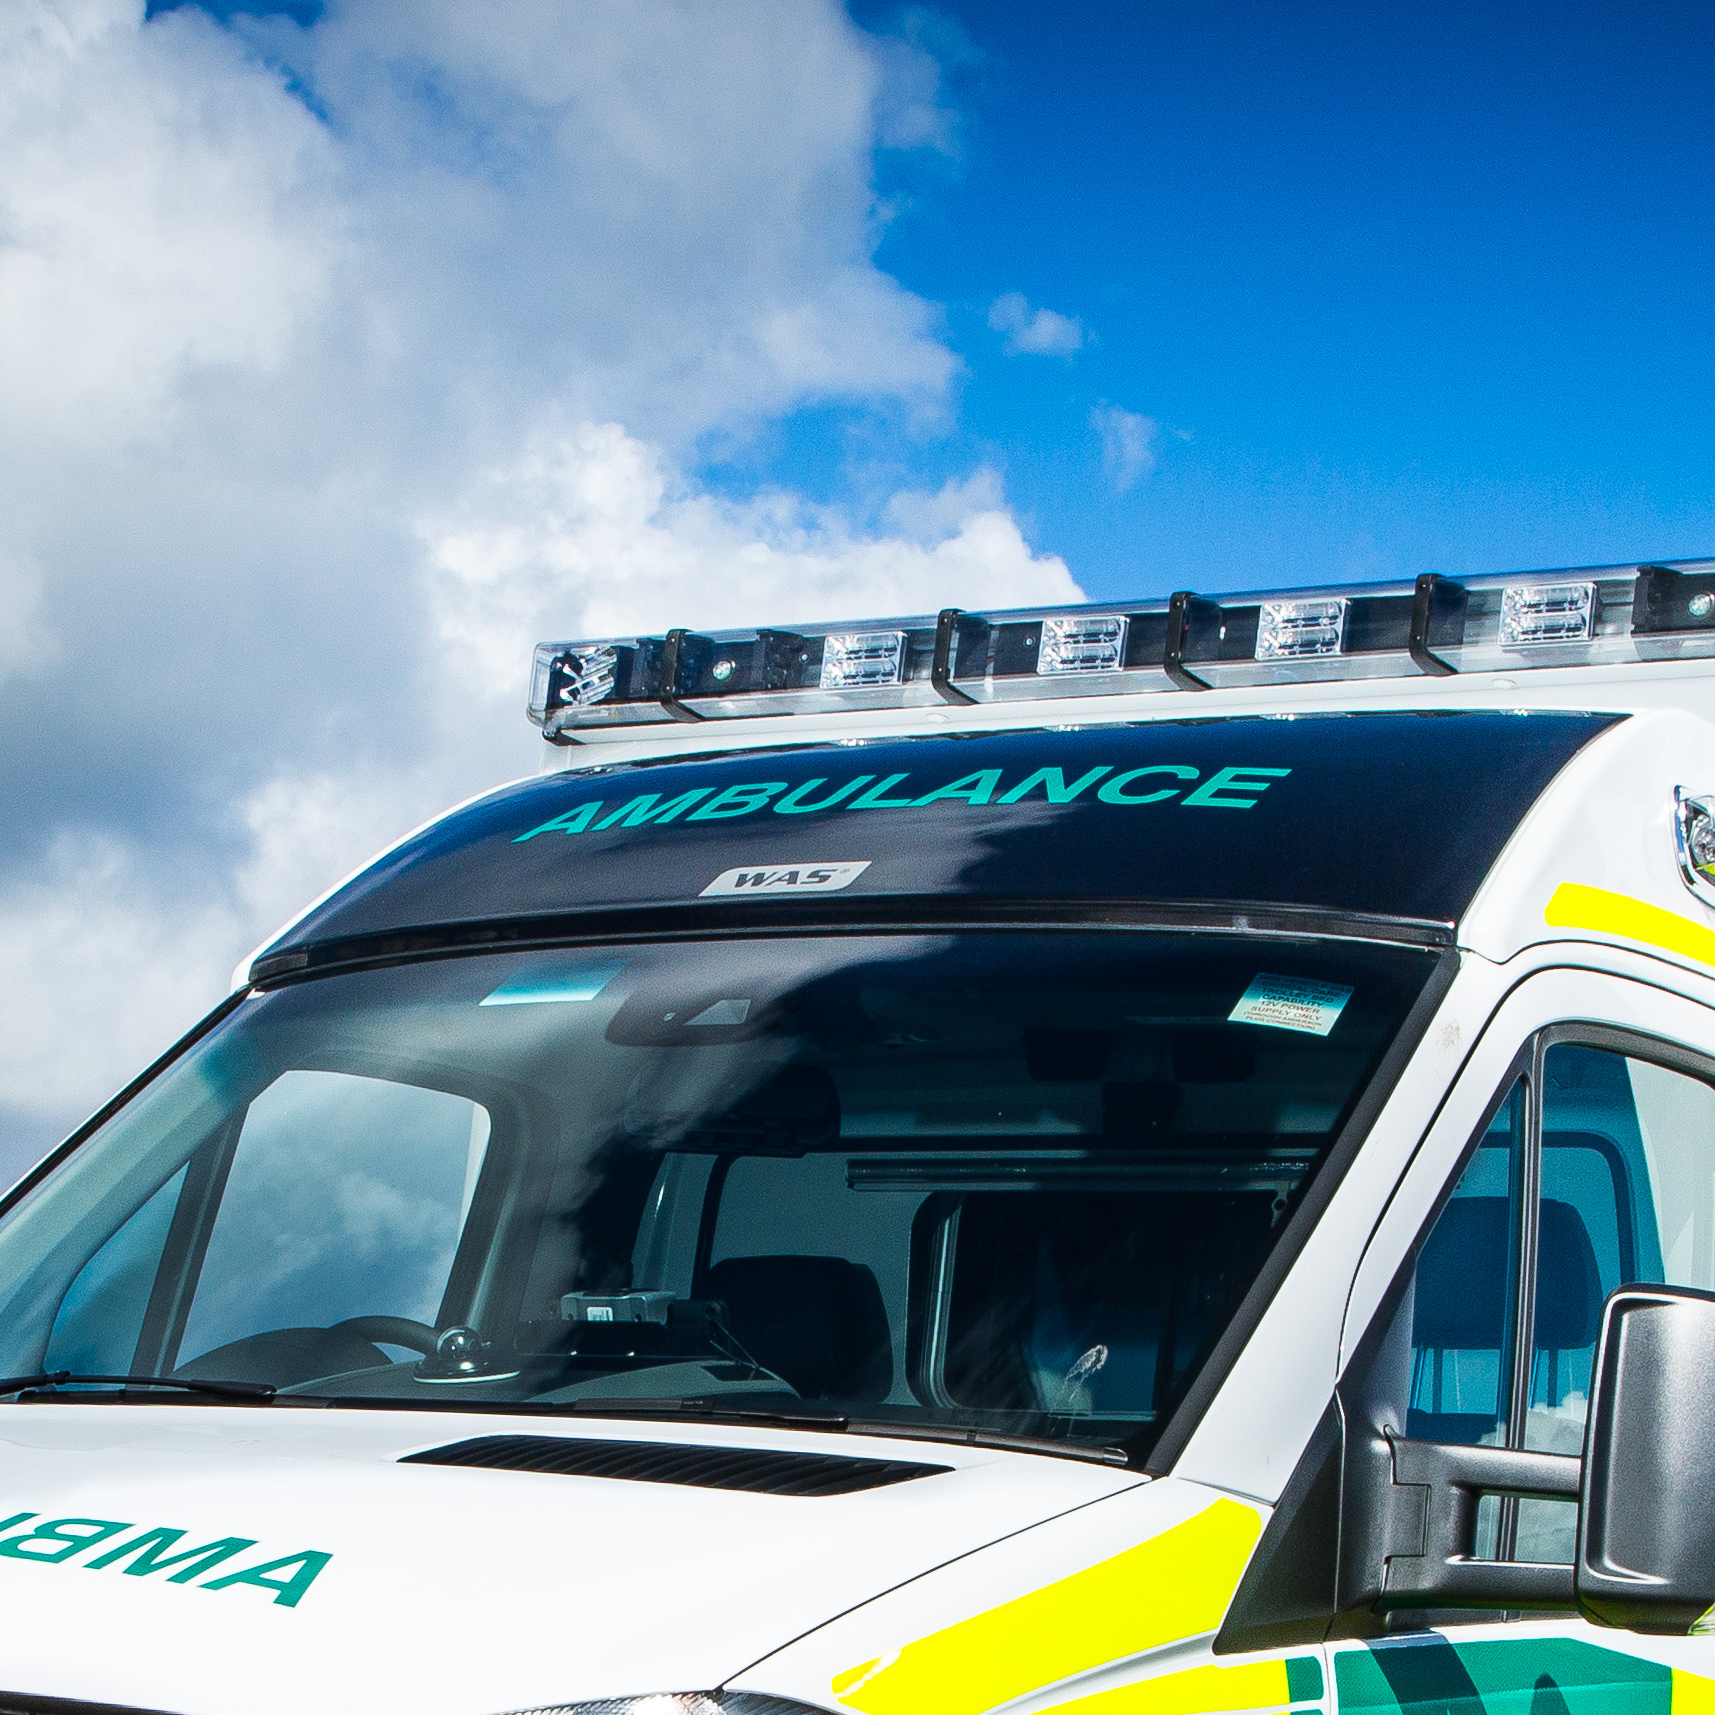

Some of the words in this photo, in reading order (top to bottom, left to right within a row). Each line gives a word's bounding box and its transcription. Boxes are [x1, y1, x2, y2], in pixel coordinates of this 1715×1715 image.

[511, 765, 1293, 843] AMBULANCE
[735, 869, 838, 888] WAS
[1261, 987, 1309, 999] TROLLEY
[1311, 994, 1335, 1003] BED
[1251, 1006, 1291, 1016] SUPPLY
[1294, 1011, 1323, 1021] ONLY
[1261, 1000, 1278, 1008] 12V
[1280, 1002, 1321, 1015] POWER
